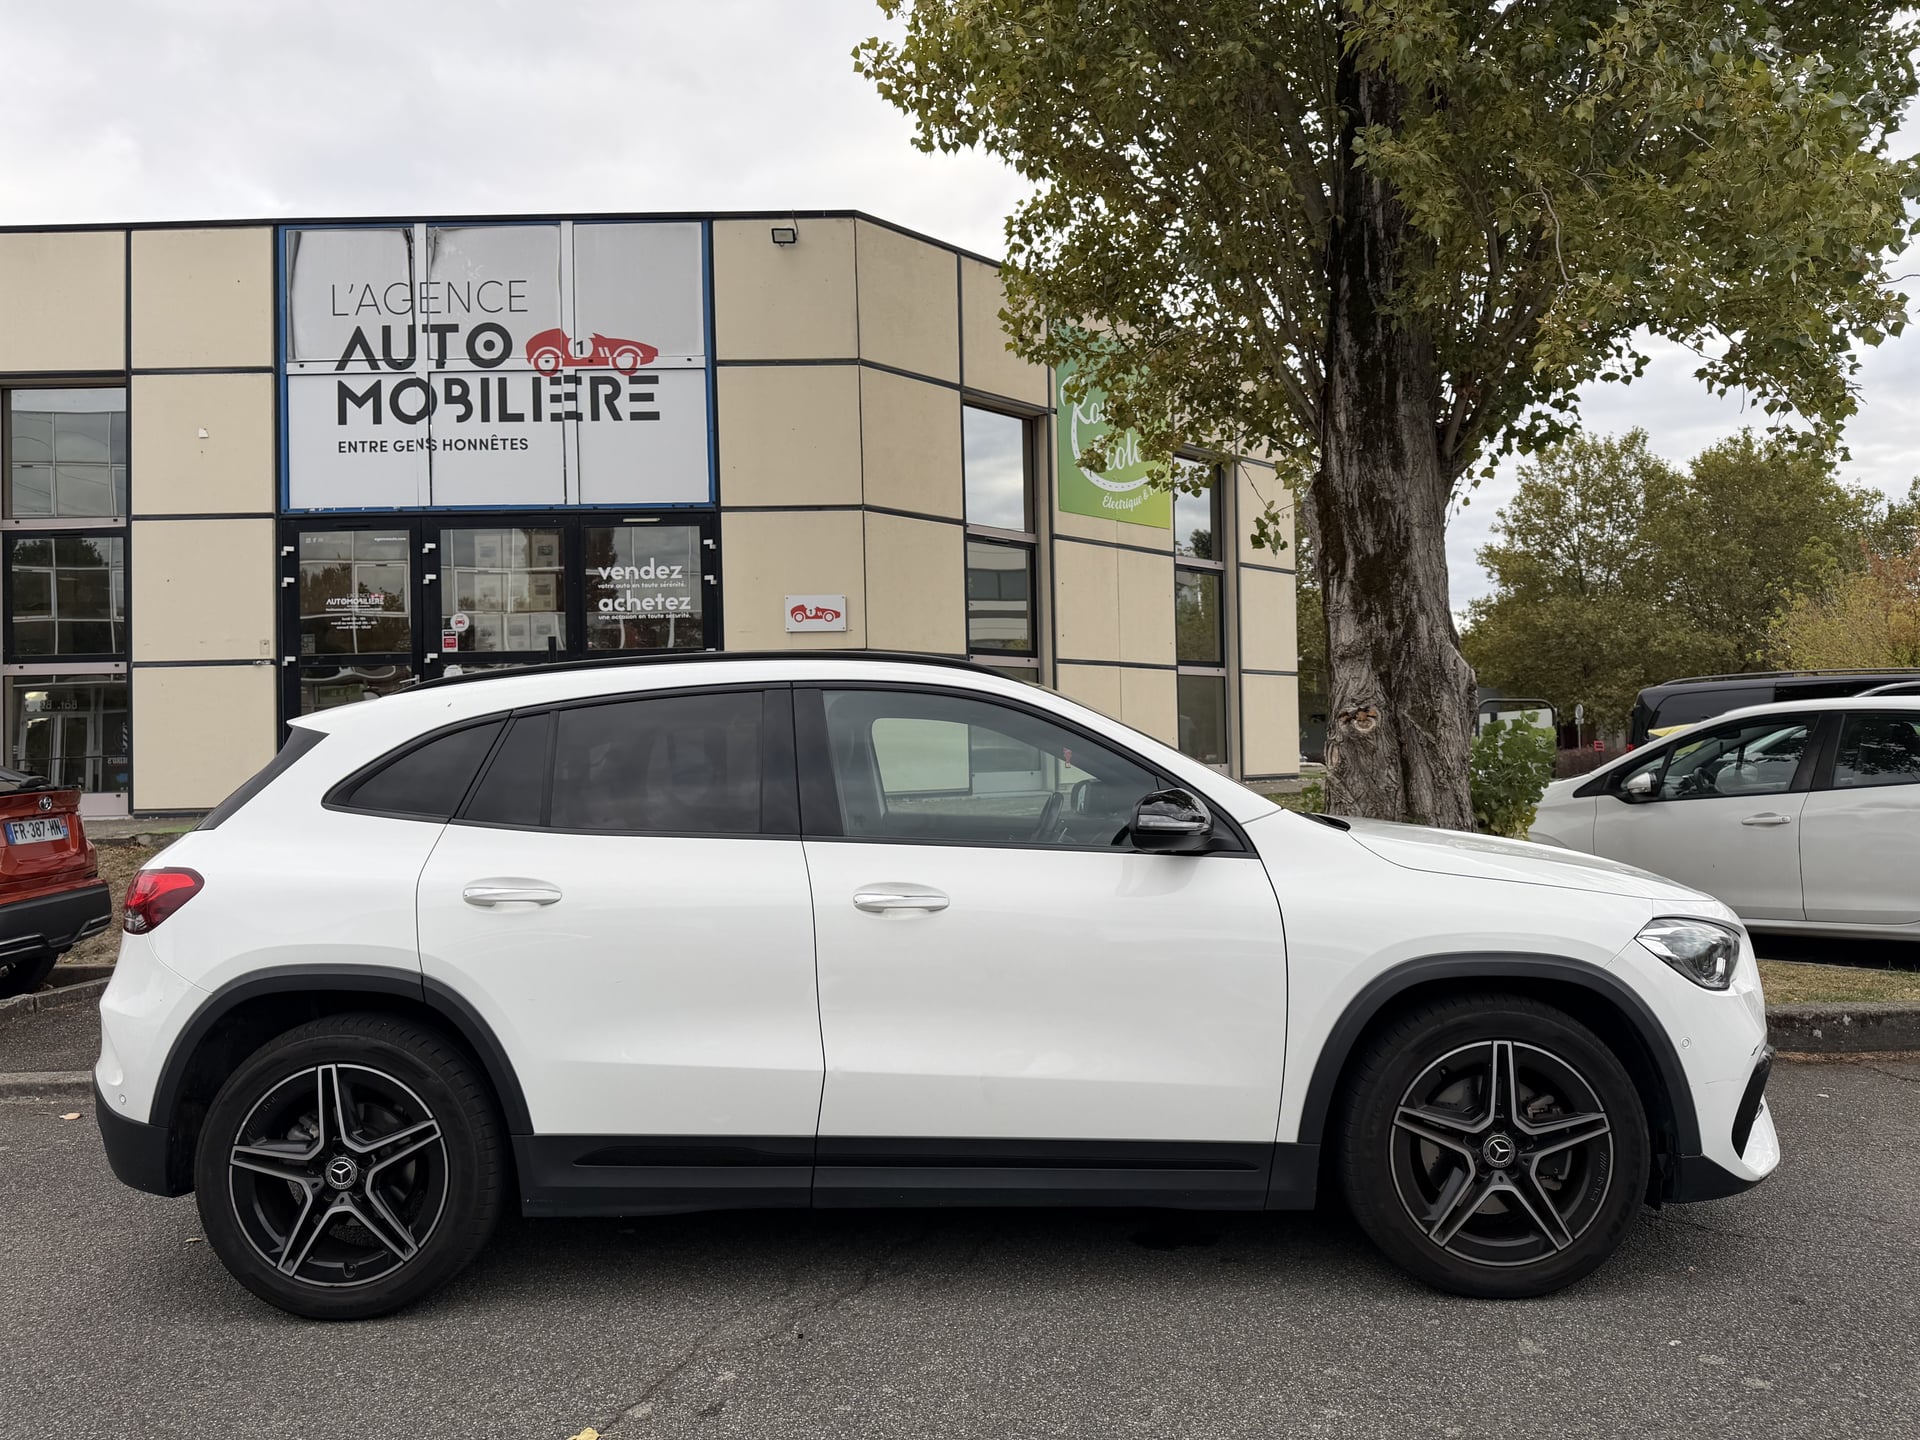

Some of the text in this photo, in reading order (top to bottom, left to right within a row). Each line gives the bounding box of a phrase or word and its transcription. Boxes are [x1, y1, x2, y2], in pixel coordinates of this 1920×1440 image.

[332, 280, 529, 316] L'AGENCE
[335, 322, 513, 371] AUTO
[576, 340, 584, 355] 1
[338, 434, 529, 453] ENTRE GENS HONNÊTES
[598, 557, 682, 580] vendez
[598, 589, 691, 612] achetez
